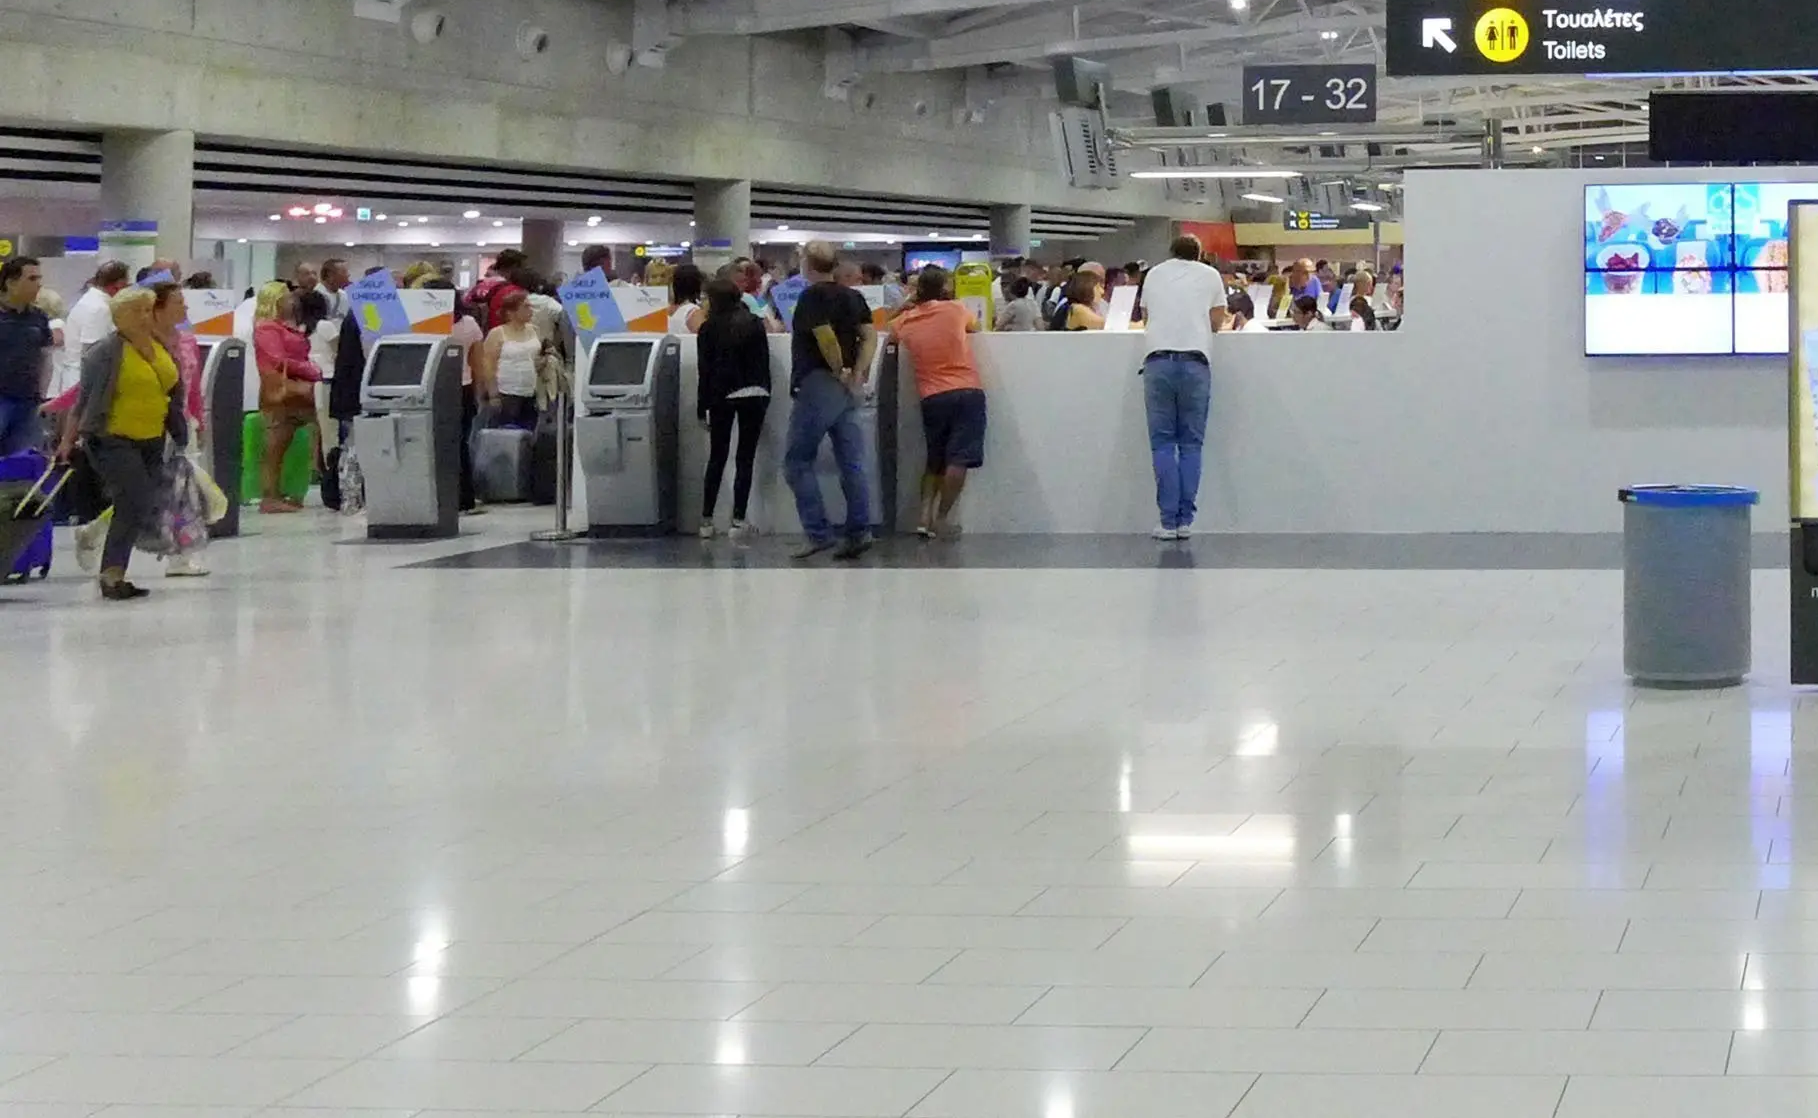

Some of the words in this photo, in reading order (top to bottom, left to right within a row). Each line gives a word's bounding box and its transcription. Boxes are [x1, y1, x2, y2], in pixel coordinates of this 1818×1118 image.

[1541, 8, 1645, 32] Τουαλέτες
[1542, 40, 1606, 60] Toilets
[1251, 78, 1291, 111] 17
[1325, 77, 1368, 110] 32
